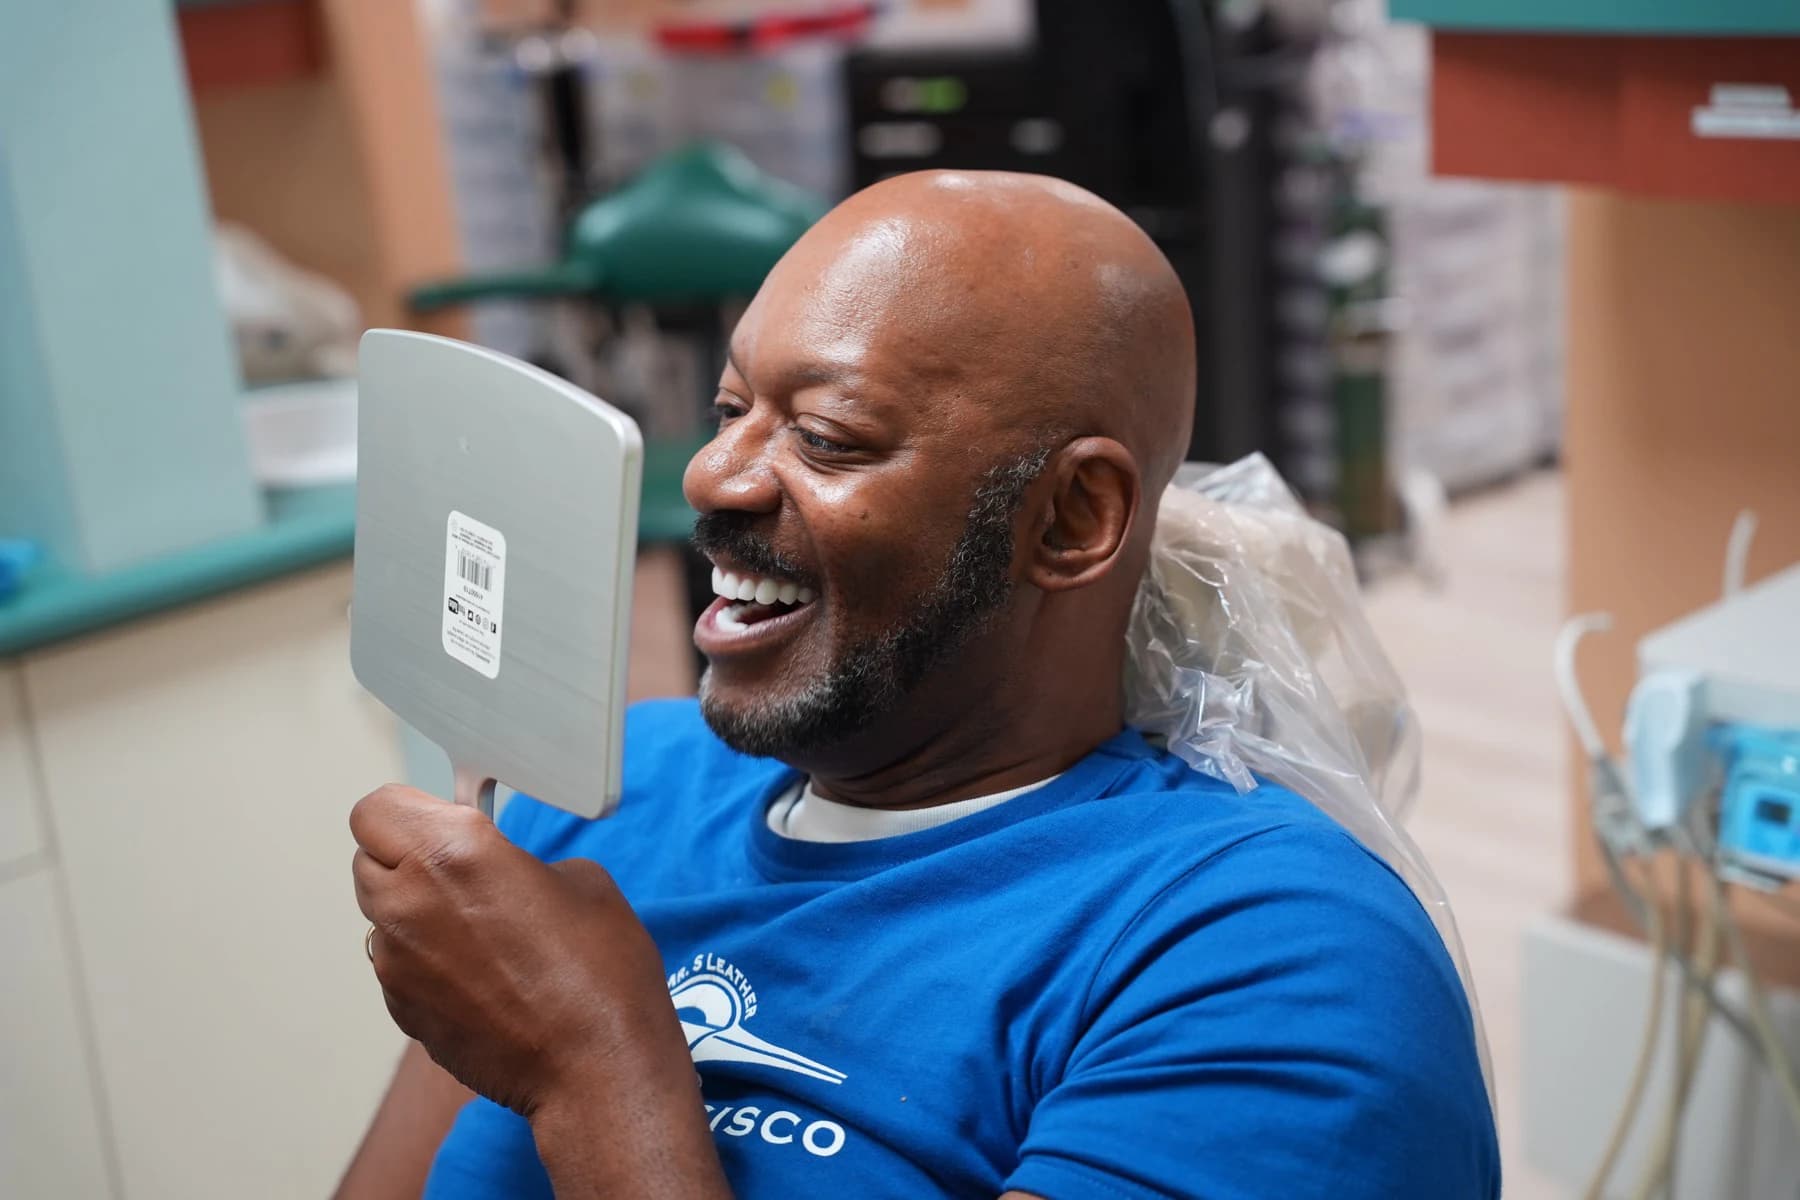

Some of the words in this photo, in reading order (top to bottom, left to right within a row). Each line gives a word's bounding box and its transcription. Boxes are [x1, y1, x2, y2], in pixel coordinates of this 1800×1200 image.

[693, 953, 704, 972] S
[706, 952, 758, 1021] LEATHER
[704, 1104, 846, 1157] ISCO
